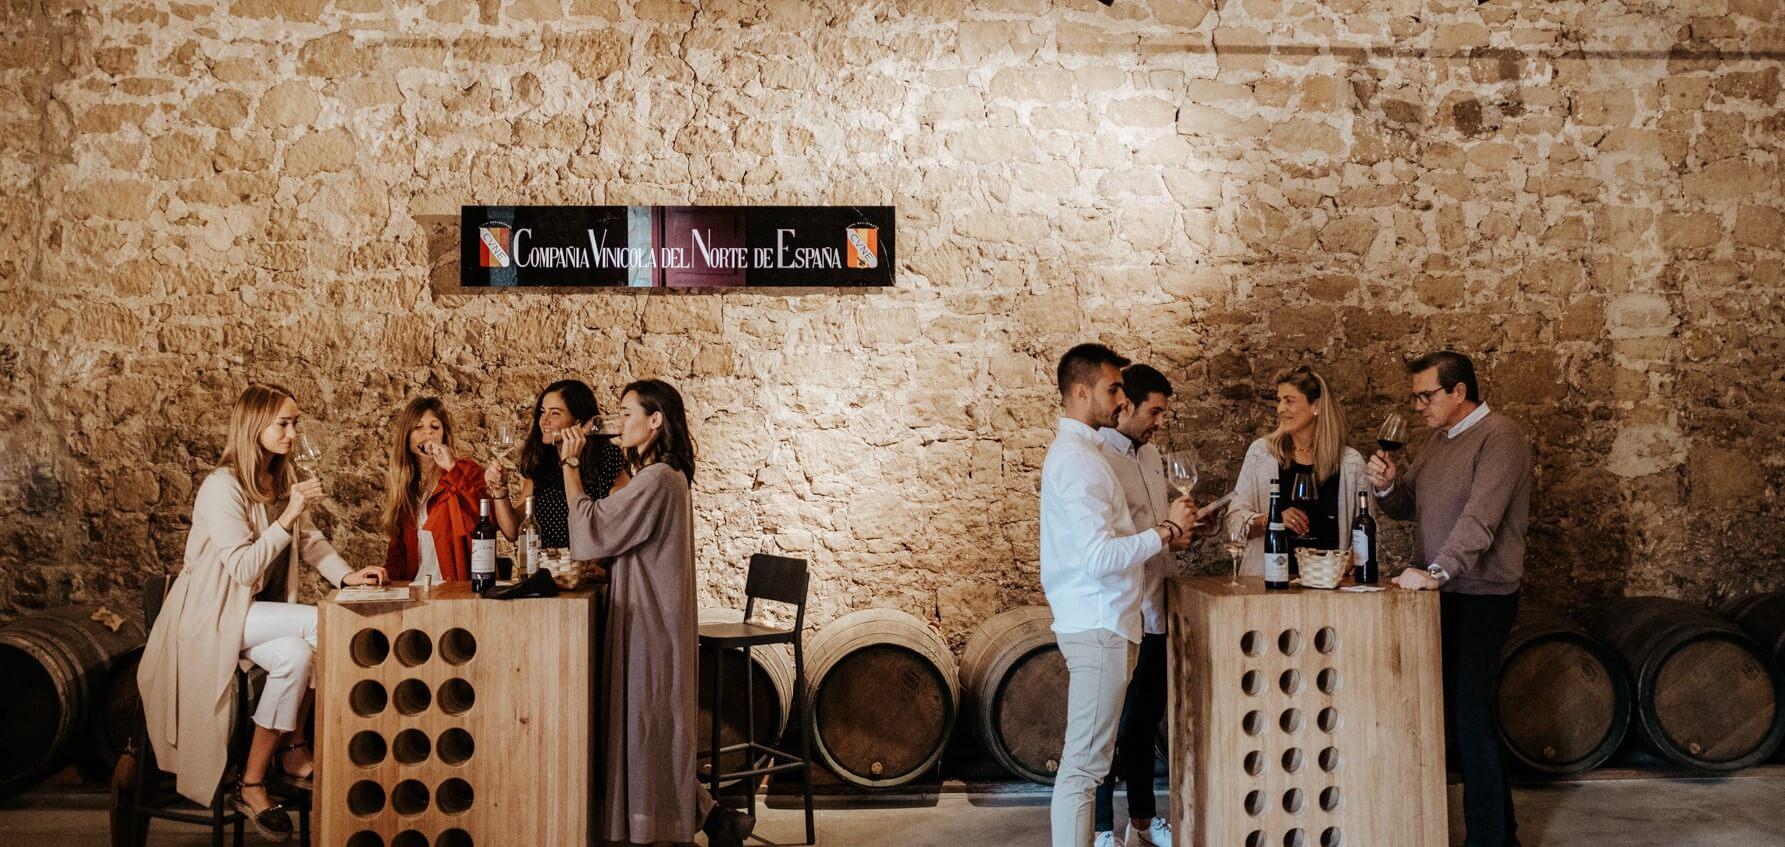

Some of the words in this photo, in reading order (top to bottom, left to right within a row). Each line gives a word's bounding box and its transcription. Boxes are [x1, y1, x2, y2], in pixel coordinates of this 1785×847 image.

[483, 233, 506, 260] CVNE
[588, 228, 657, 268] VINICOLA
[661, 247, 690, 268] DEL
[691, 228, 748, 268] NORTE
[754, 247, 773, 268] DE
[777, 228, 842, 269] ESPAÑA
[850, 233, 874, 262] CVNE
